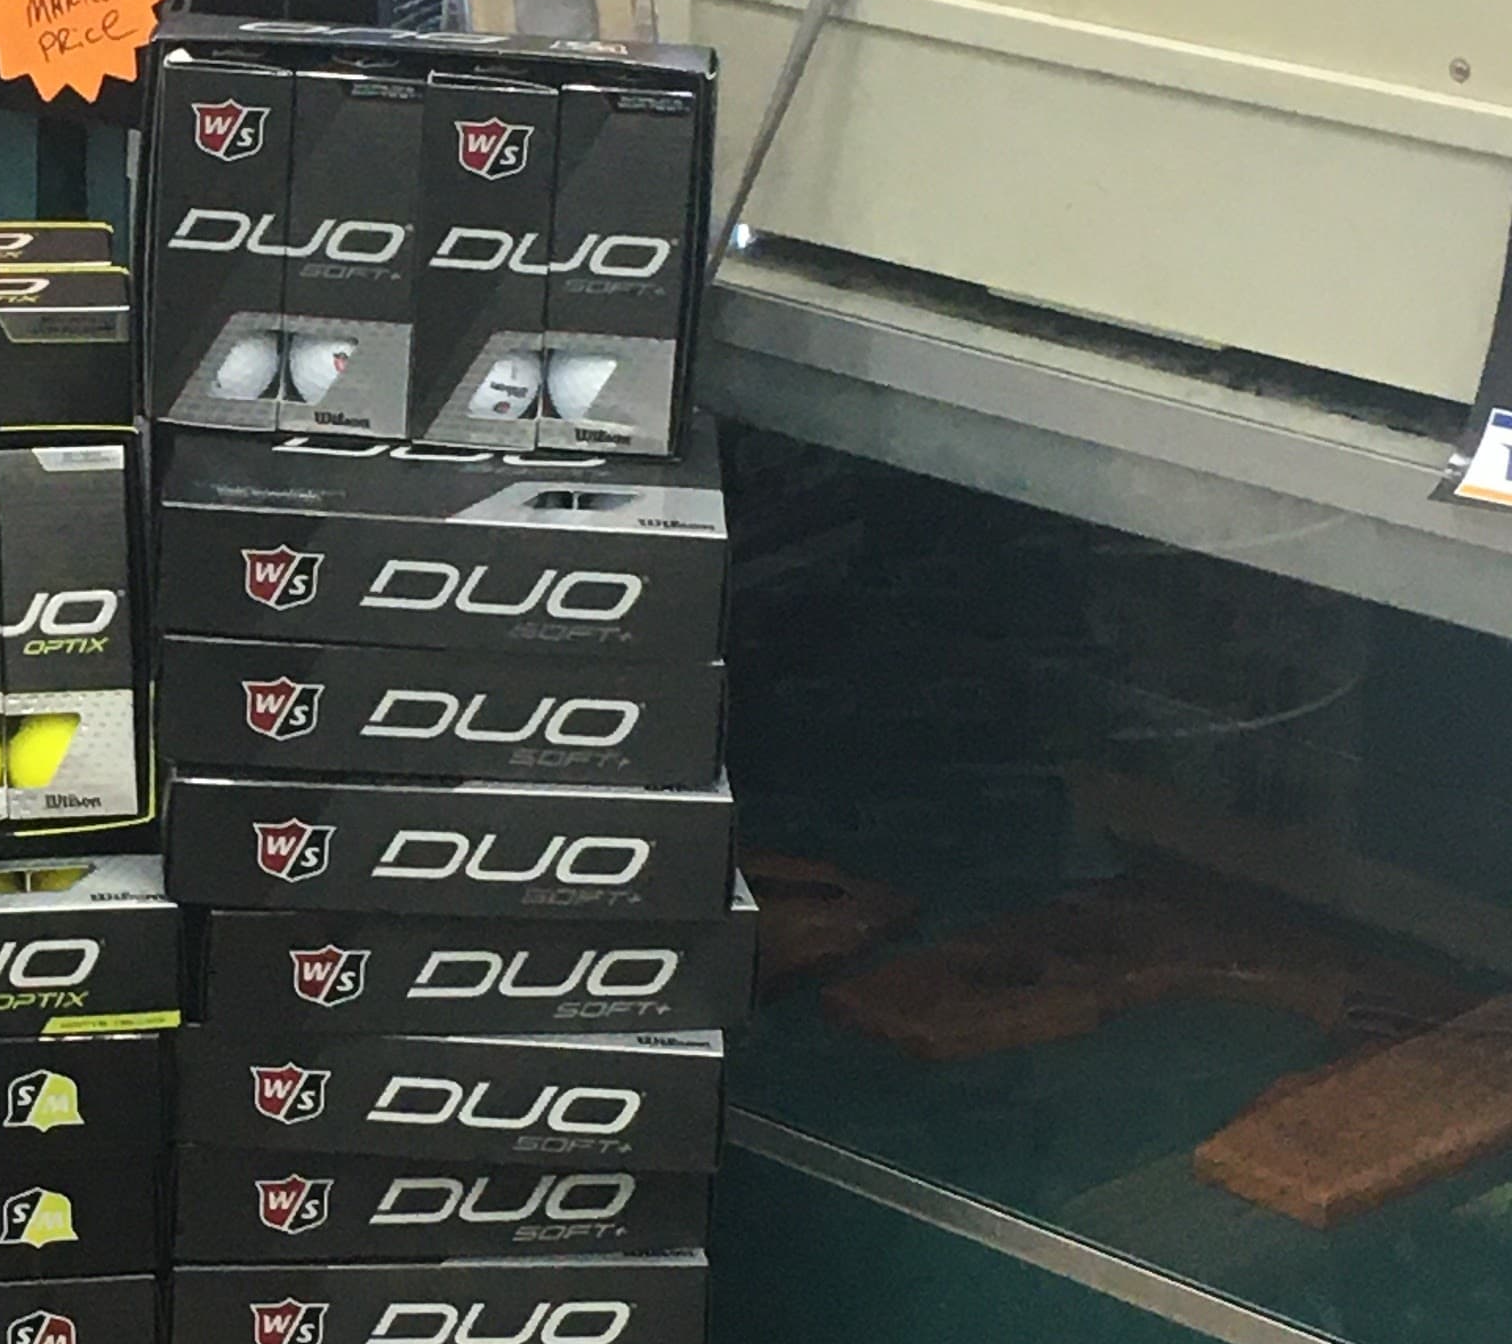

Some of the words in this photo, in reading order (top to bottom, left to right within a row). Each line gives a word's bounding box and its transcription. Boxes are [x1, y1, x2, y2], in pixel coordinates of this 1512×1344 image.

[168, 207, 405, 264] DUO
[428, 227, 672, 278] DUO
[314, 410, 371, 430] Wilson
[574, 426, 632, 446] Wilson
[360, 559, 644, 620] DUO
[22, 635, 110, 656] OPTIX
[360, 689, 640, 746] DUO
[44, 792, 102, 810] Wilson
[371, 829, 650, 885] DUO
[406, 948, 680, 999] DUO
[366, 1075, 641, 1134] DUO
[368, 1172, 637, 1225] DUO
